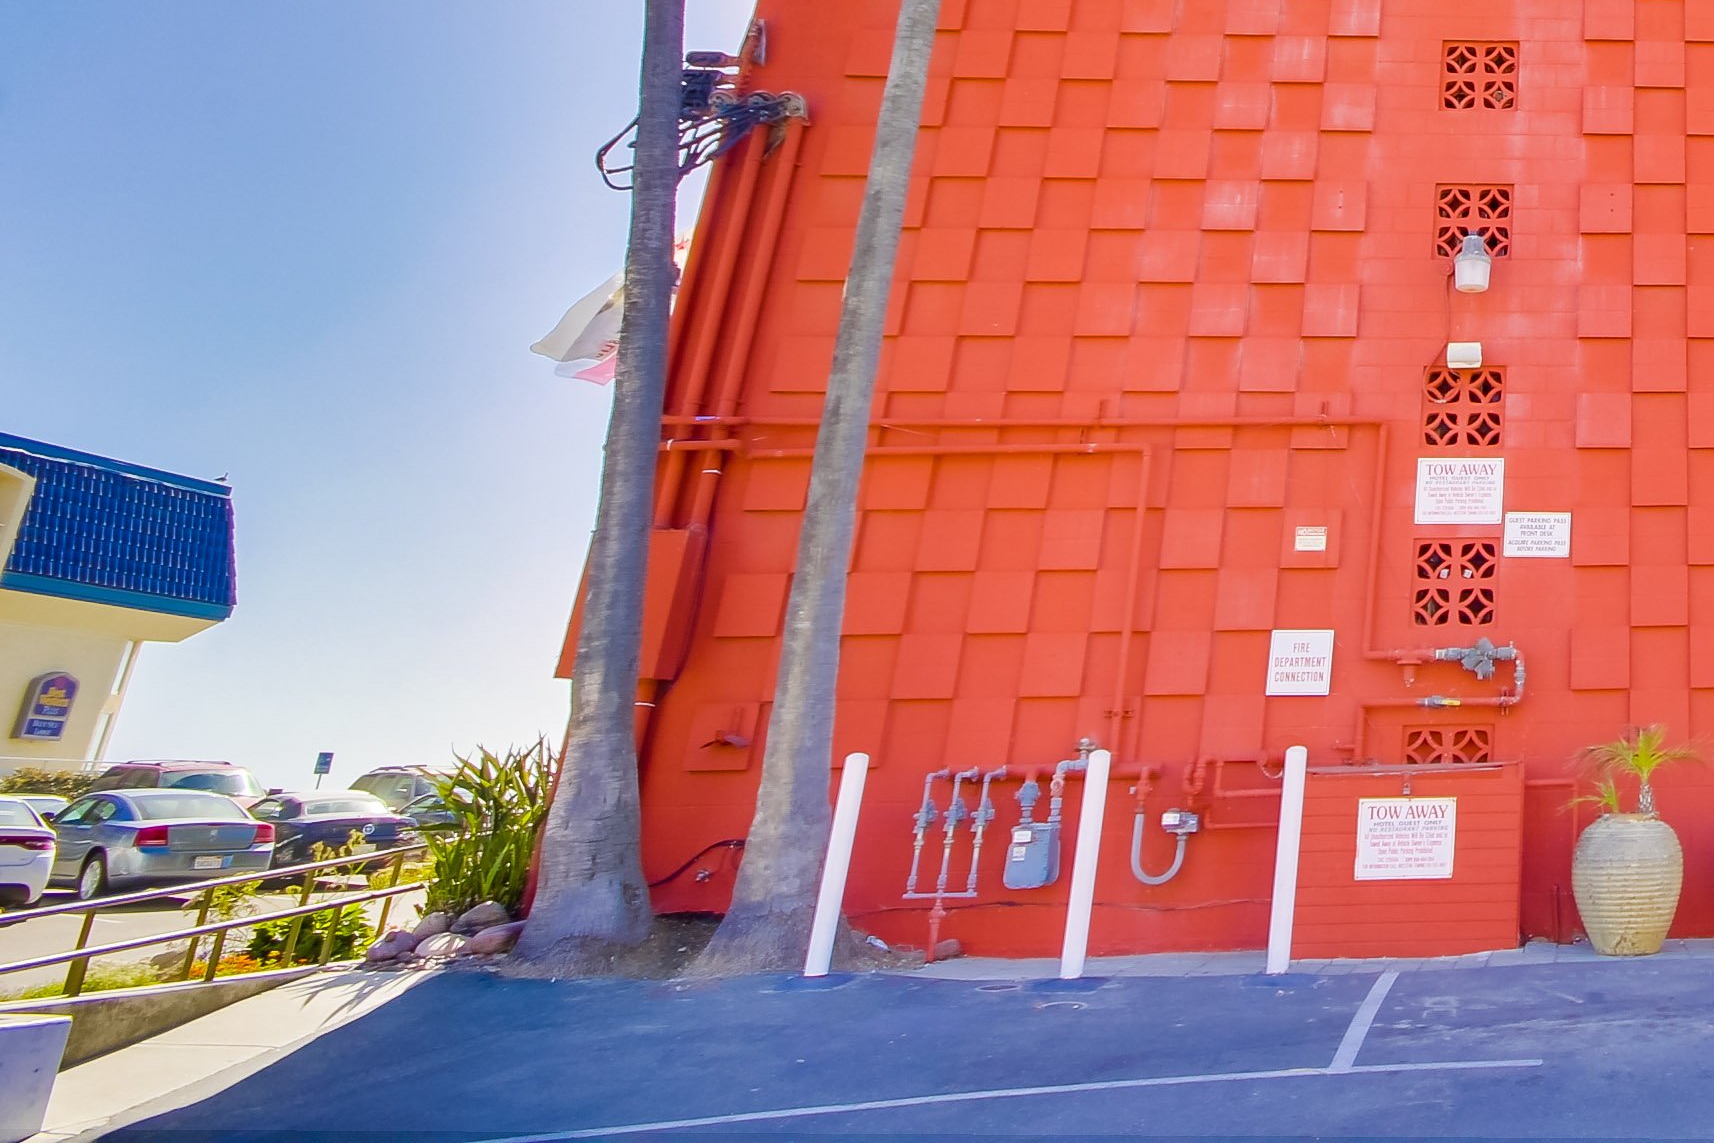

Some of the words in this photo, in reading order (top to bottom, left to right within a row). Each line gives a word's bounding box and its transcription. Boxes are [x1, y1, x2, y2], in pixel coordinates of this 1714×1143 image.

[1426, 464, 1456, 476] TOW
[1458, 464, 1497, 476] AWAY
[1293, 642, 1311, 653] FIRE
[1274, 657, 1327, 668] DEPARTMENT
[1274, 671, 1324, 682] CONNECTION
[1368, 805, 1402, 820] TOW
[1405, 804, 1449, 819] AWAY
